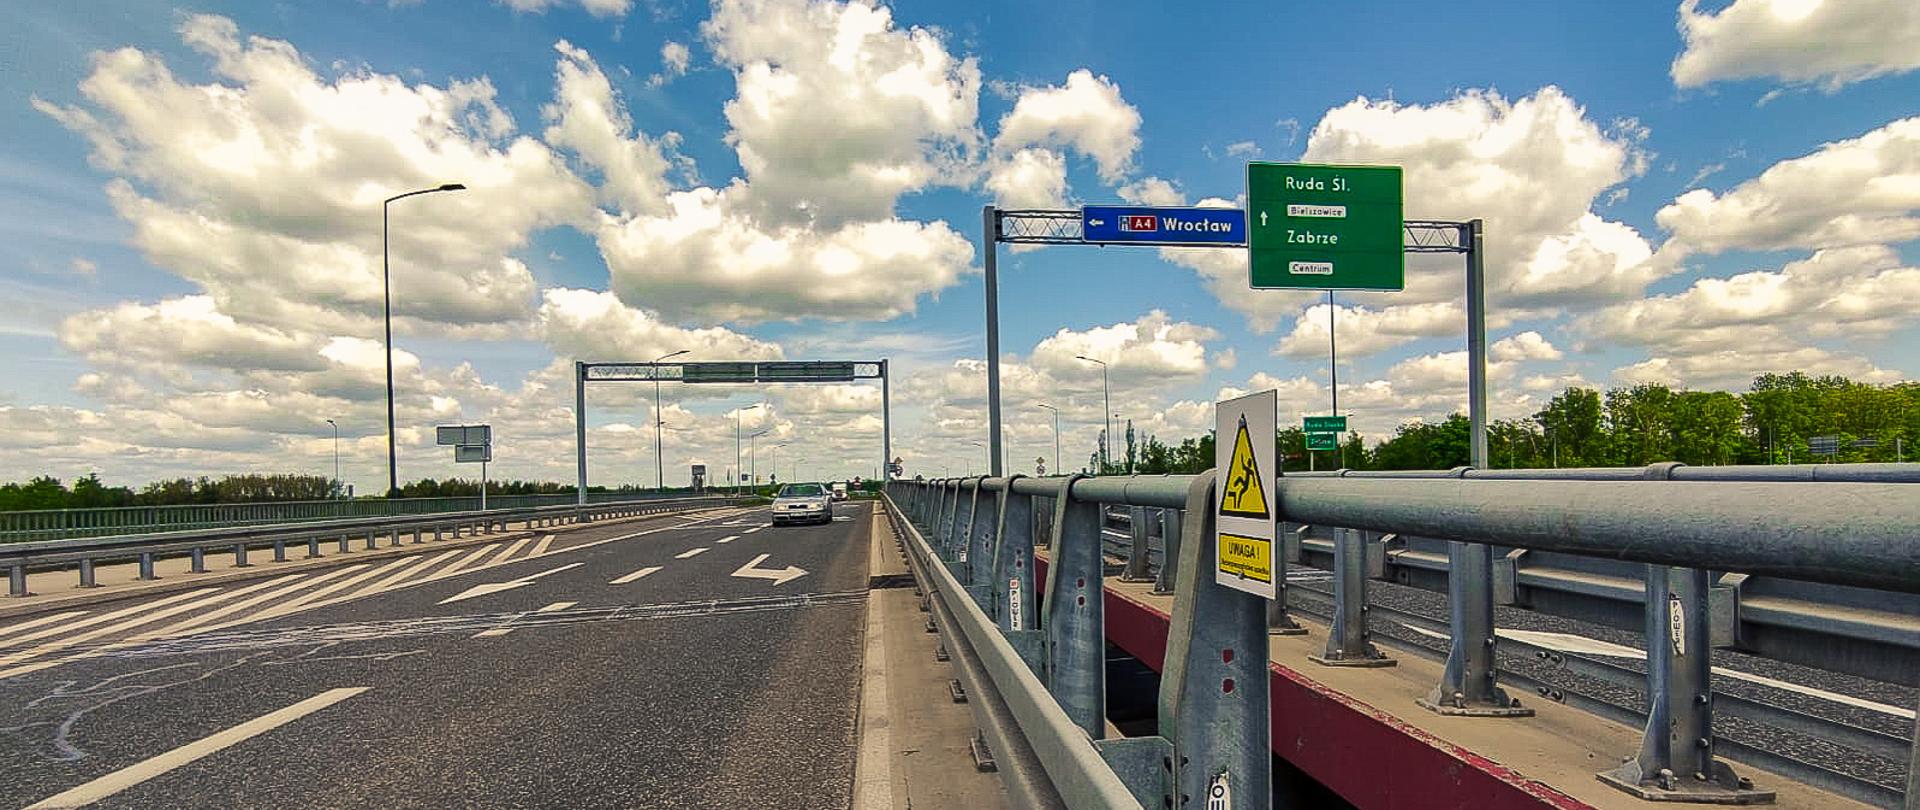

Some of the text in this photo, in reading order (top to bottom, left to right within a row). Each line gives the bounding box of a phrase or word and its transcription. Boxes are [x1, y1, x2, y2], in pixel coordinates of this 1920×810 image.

[1286, 174, 1351, 192] Ruda Śl.
[1135, 217, 1232, 232] A4 Wrocław
[1287, 230, 1338, 244] Zabrze
[1292, 263, 1330, 273] Centrum
